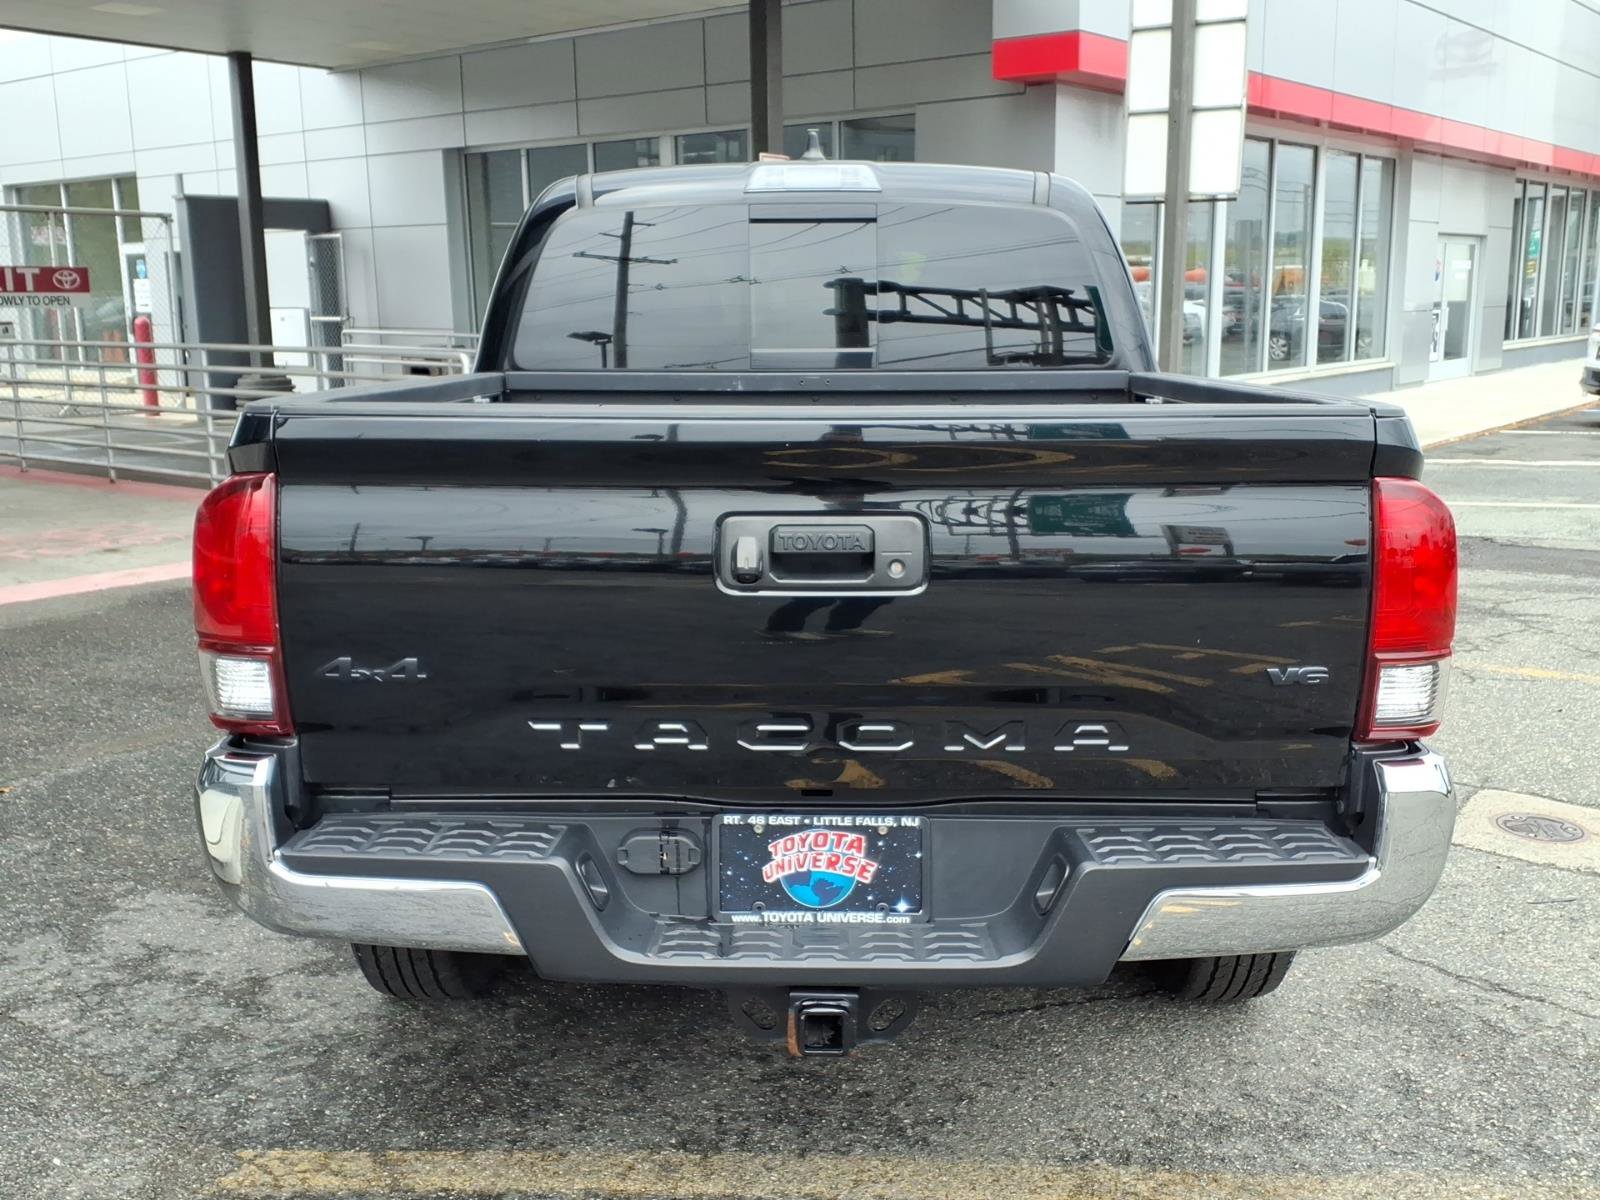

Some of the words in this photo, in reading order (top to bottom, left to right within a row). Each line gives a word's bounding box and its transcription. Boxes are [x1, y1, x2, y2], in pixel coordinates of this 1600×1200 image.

[0, 267, 40, 291] IT
[26, 295, 41, 306] TO
[42, 295, 71, 306] OPEN
[779, 533, 866, 551] TOYOTA
[1264, 665, 1329, 685] V6
[527, 718, 1131, 752] TACOMA
[723, 815, 744, 825] RT.
[747, 815, 765, 825] 46
[768, 815, 801, 826] EAST
[813, 816, 852, 826] LITTLE
[855, 816, 897, 827] FALLS,
[901, 817, 920, 827] NJ
[768, 831, 867, 858] TOYOTA
[762, 851, 878, 883] UNIVERSE
[731, 912, 814, 923] www.TOYOTA
[816, 912, 911, 924] UNIVERSE.com
